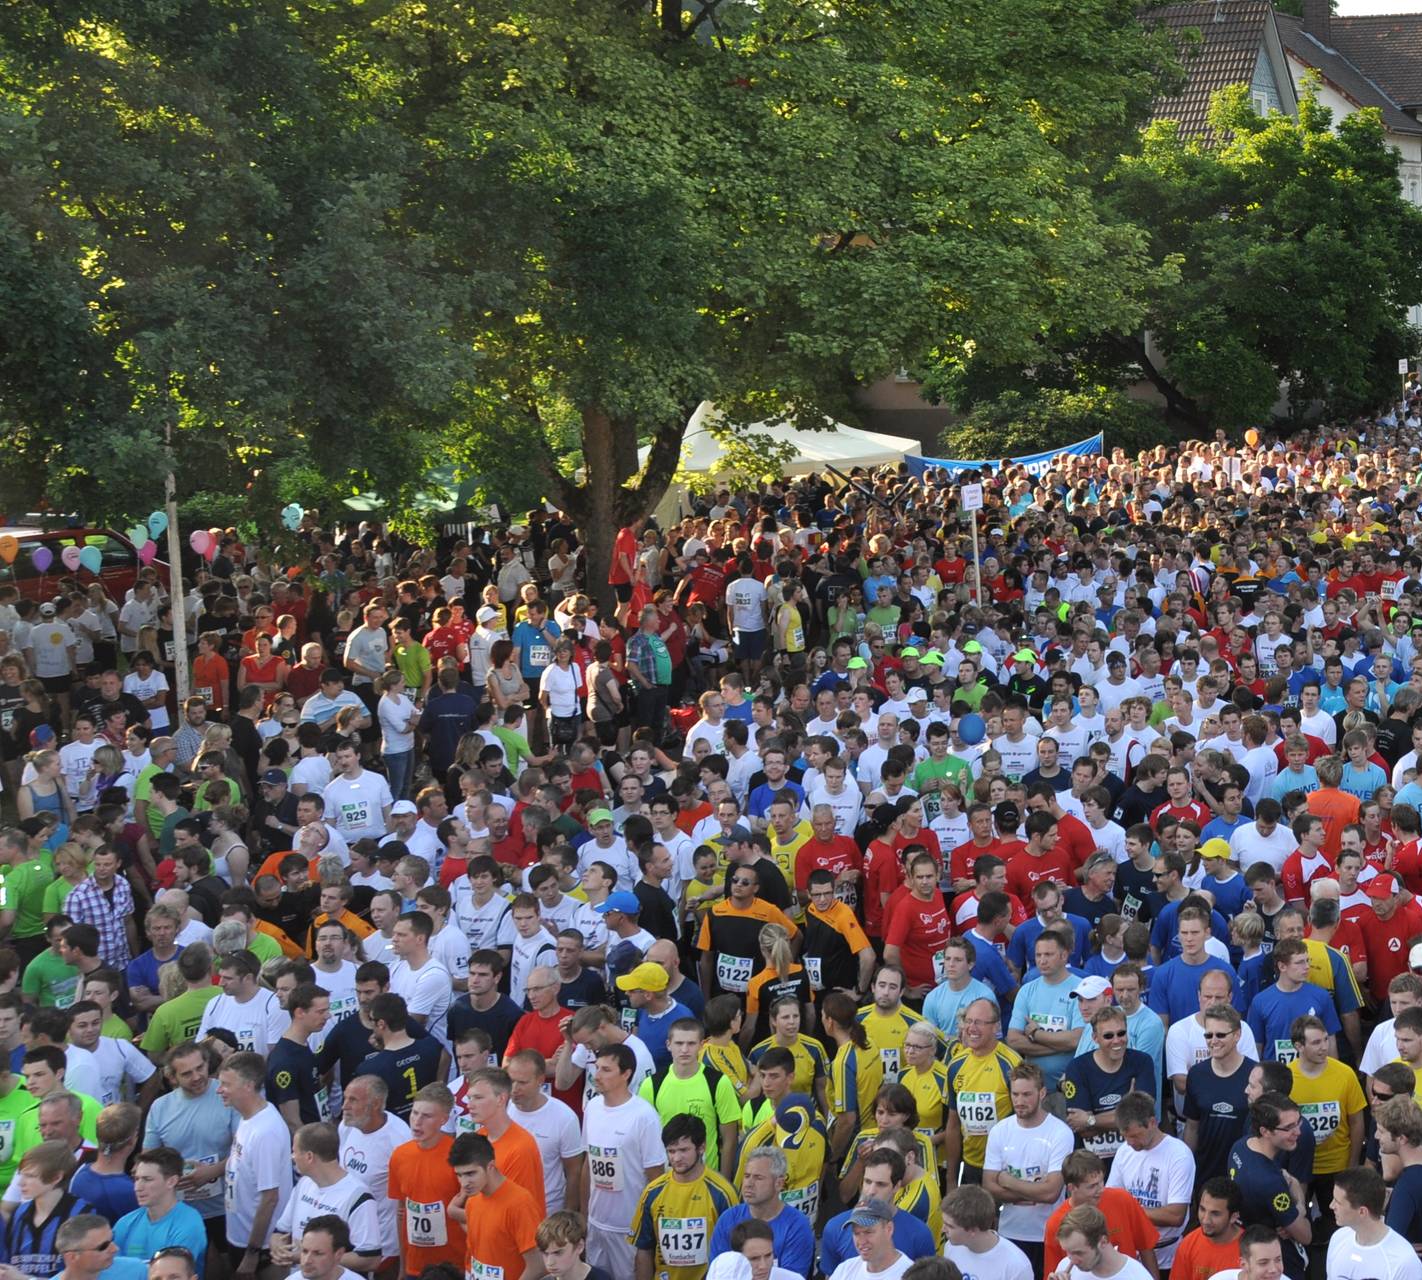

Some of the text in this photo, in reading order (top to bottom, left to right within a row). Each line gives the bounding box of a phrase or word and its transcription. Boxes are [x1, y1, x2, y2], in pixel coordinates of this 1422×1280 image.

[345, 809, 368, 823] 929
[927, 802, 941, 813] 63
[1122, 903, 1138, 919] 69
[717, 965, 752, 982] 6122
[959, 1105, 994, 1122] 4162
[345, 1158, 368, 1174] AWO
[592, 1159, 616, 1178] 886
[411, 1216, 432, 1234] 70
[661, 1232, 706, 1251] 4137
